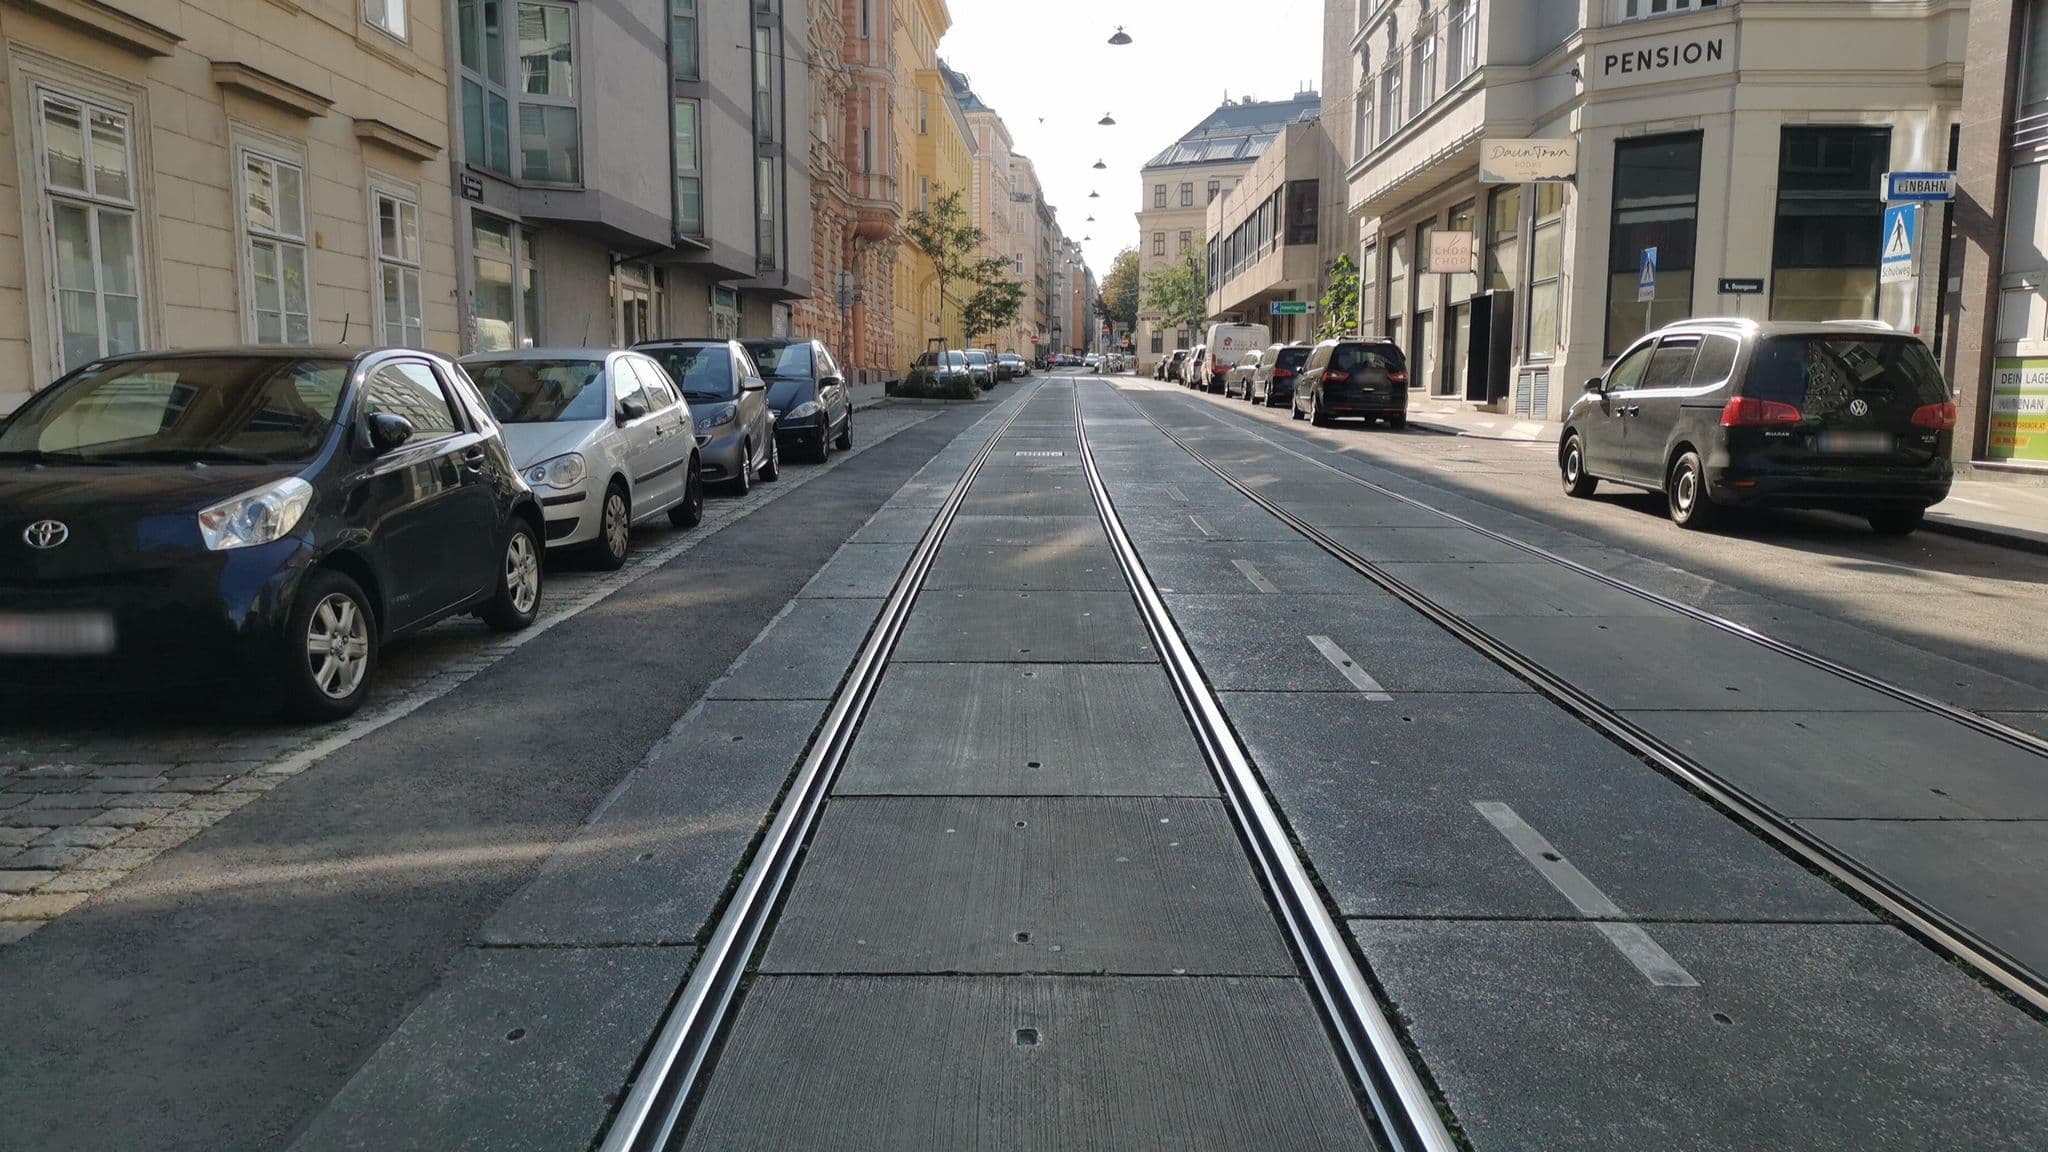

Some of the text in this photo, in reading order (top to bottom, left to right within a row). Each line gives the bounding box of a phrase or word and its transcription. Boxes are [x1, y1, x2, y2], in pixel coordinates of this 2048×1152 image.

[1605, 39, 1723, 75] PENSION
[1898, 180, 1947, 193] EINBAHN
[1435, 246, 1467, 256] CHOP
[1435, 256, 1466, 265] CHOP
[1882, 265, 1911, 278] Schulweg
[2001, 372, 2022, 385] DEIN
